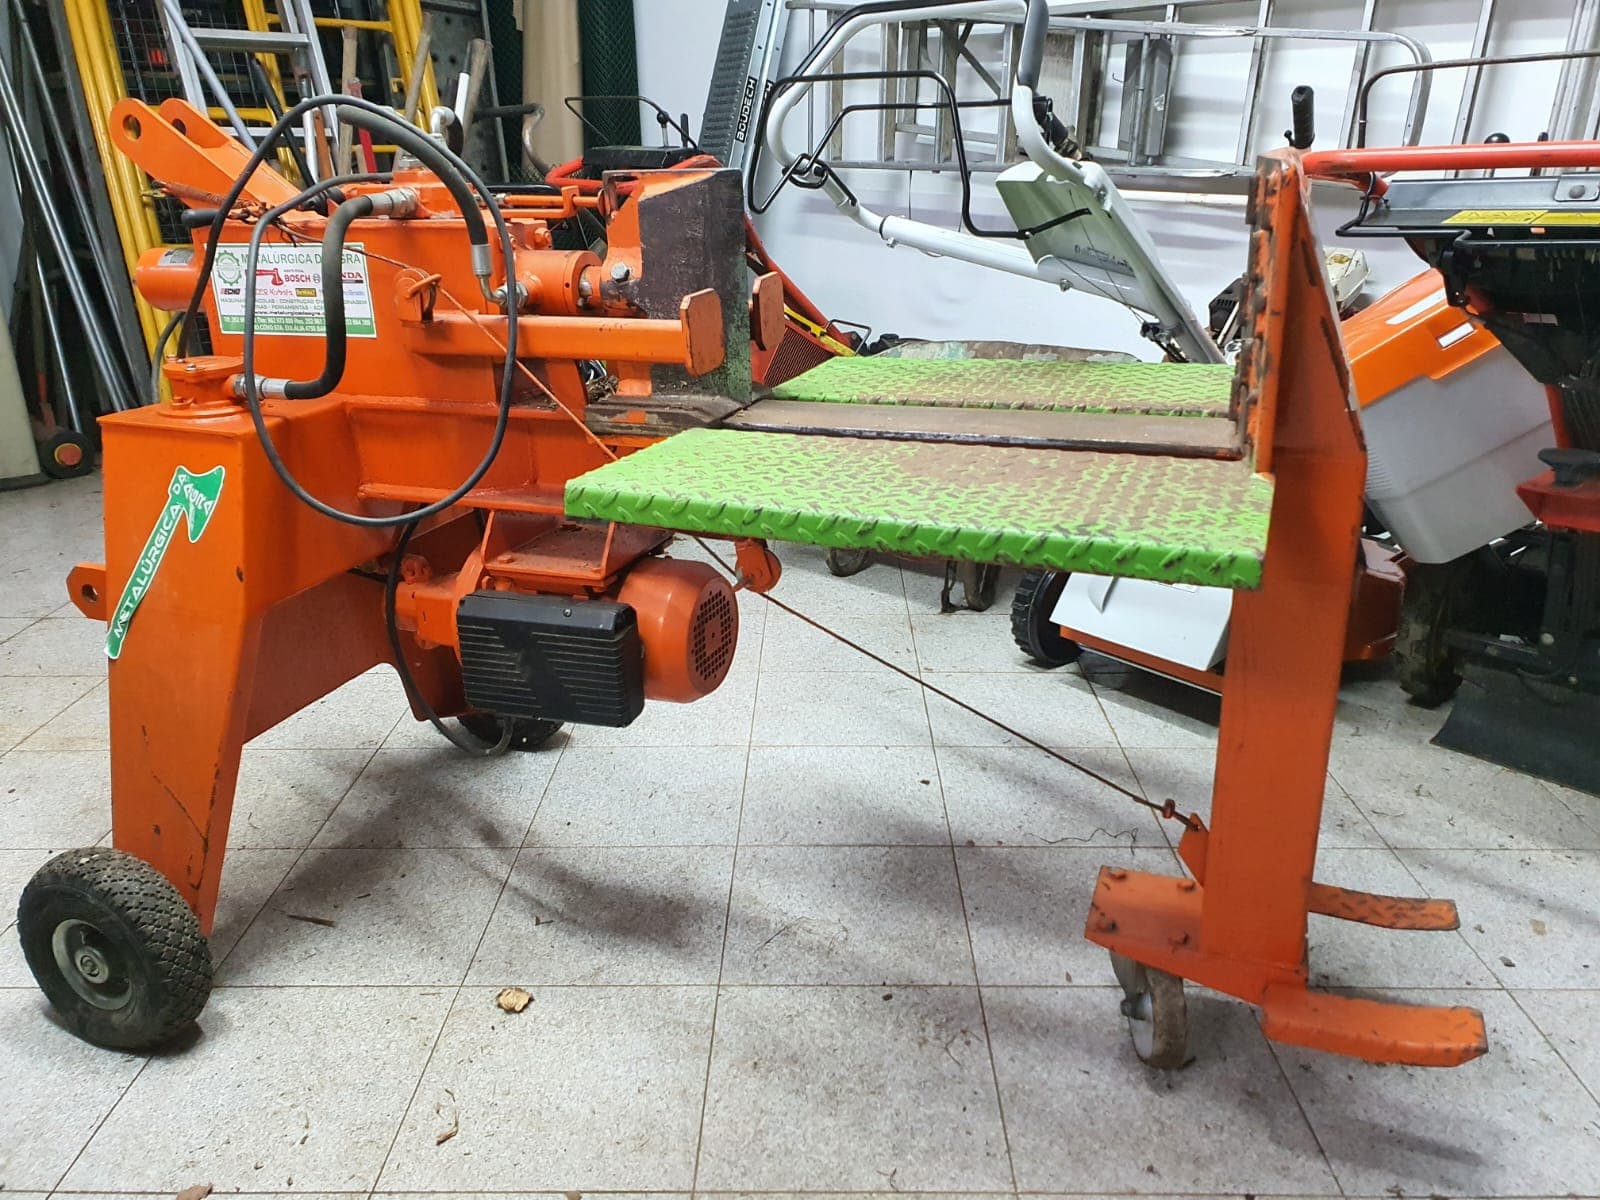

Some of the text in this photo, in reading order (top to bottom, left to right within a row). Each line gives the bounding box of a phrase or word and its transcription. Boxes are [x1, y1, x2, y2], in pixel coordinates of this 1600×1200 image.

[736, 78, 756, 141] BOUDECH
[284, 274, 311, 283] BOSCH
[341, 271, 363, 279] NDA
[172, 473, 187, 496] DA
[113, 503, 181, 638] METALÚRGICA
